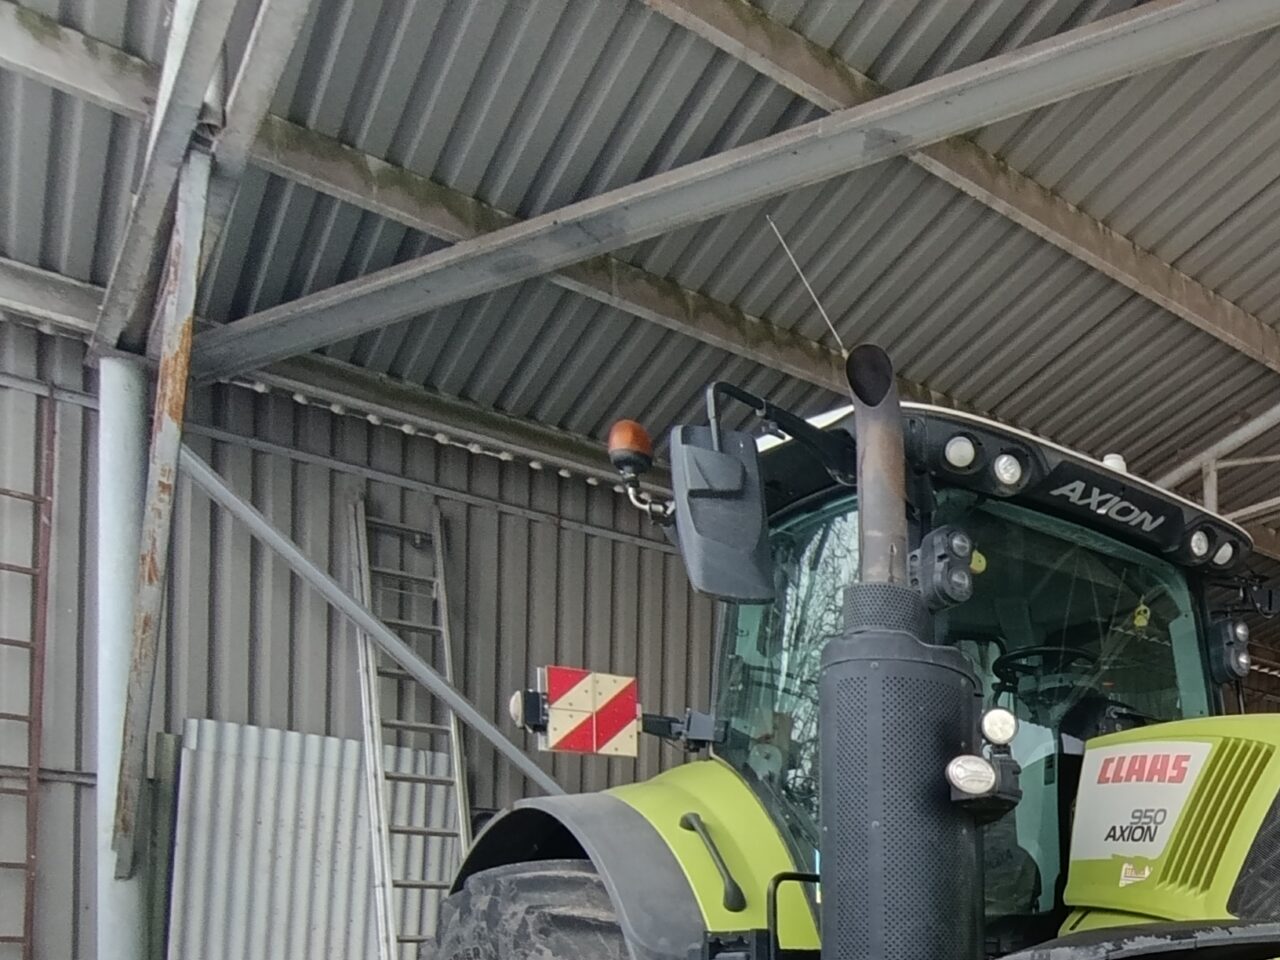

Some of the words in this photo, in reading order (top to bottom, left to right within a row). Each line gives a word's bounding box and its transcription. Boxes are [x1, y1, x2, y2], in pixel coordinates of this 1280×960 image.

[1050, 479, 1165, 532] AXION
[1097, 754, 1192, 785] CLAAS
[1130, 808, 1168, 826] 950
[1104, 825, 1158, 842] AXION
